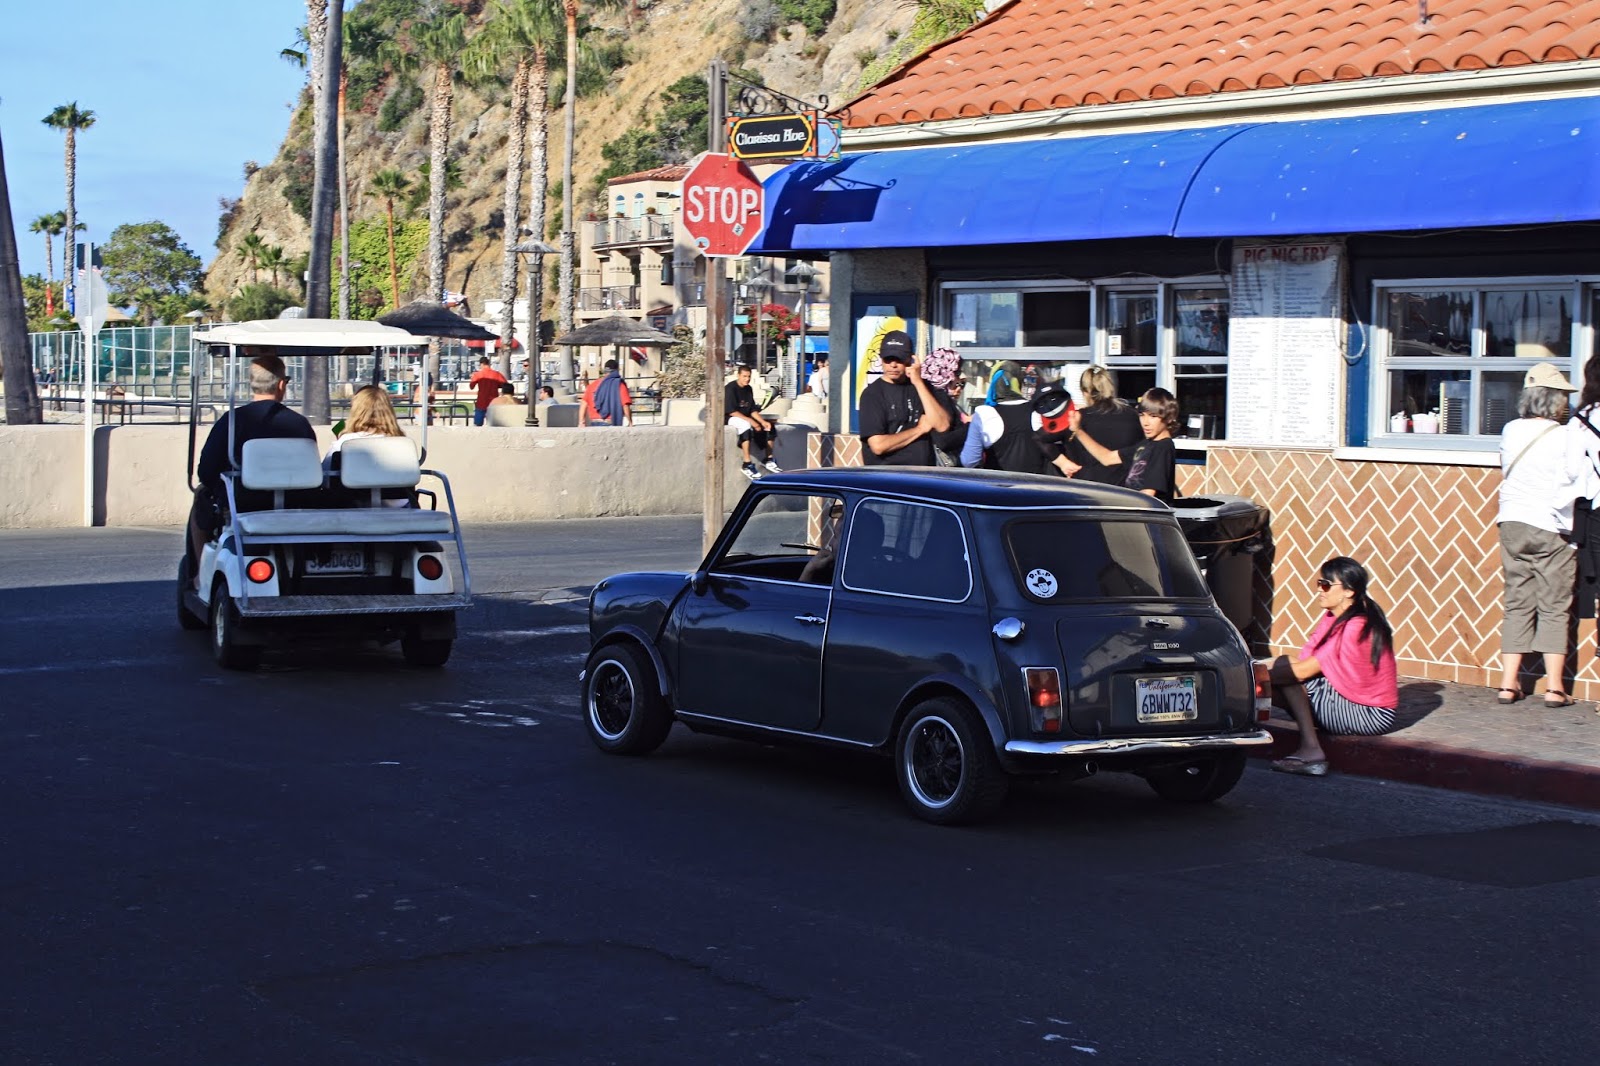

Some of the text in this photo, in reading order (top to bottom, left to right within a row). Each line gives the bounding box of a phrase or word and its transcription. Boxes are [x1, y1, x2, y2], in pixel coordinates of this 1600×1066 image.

[736, 131, 780, 145] Clarissa
[687, 185, 758, 224] STOP
[1244, 246, 1329, 262] PIC NIC FRY
[1142, 692, 1192, 714] 6BWW732
